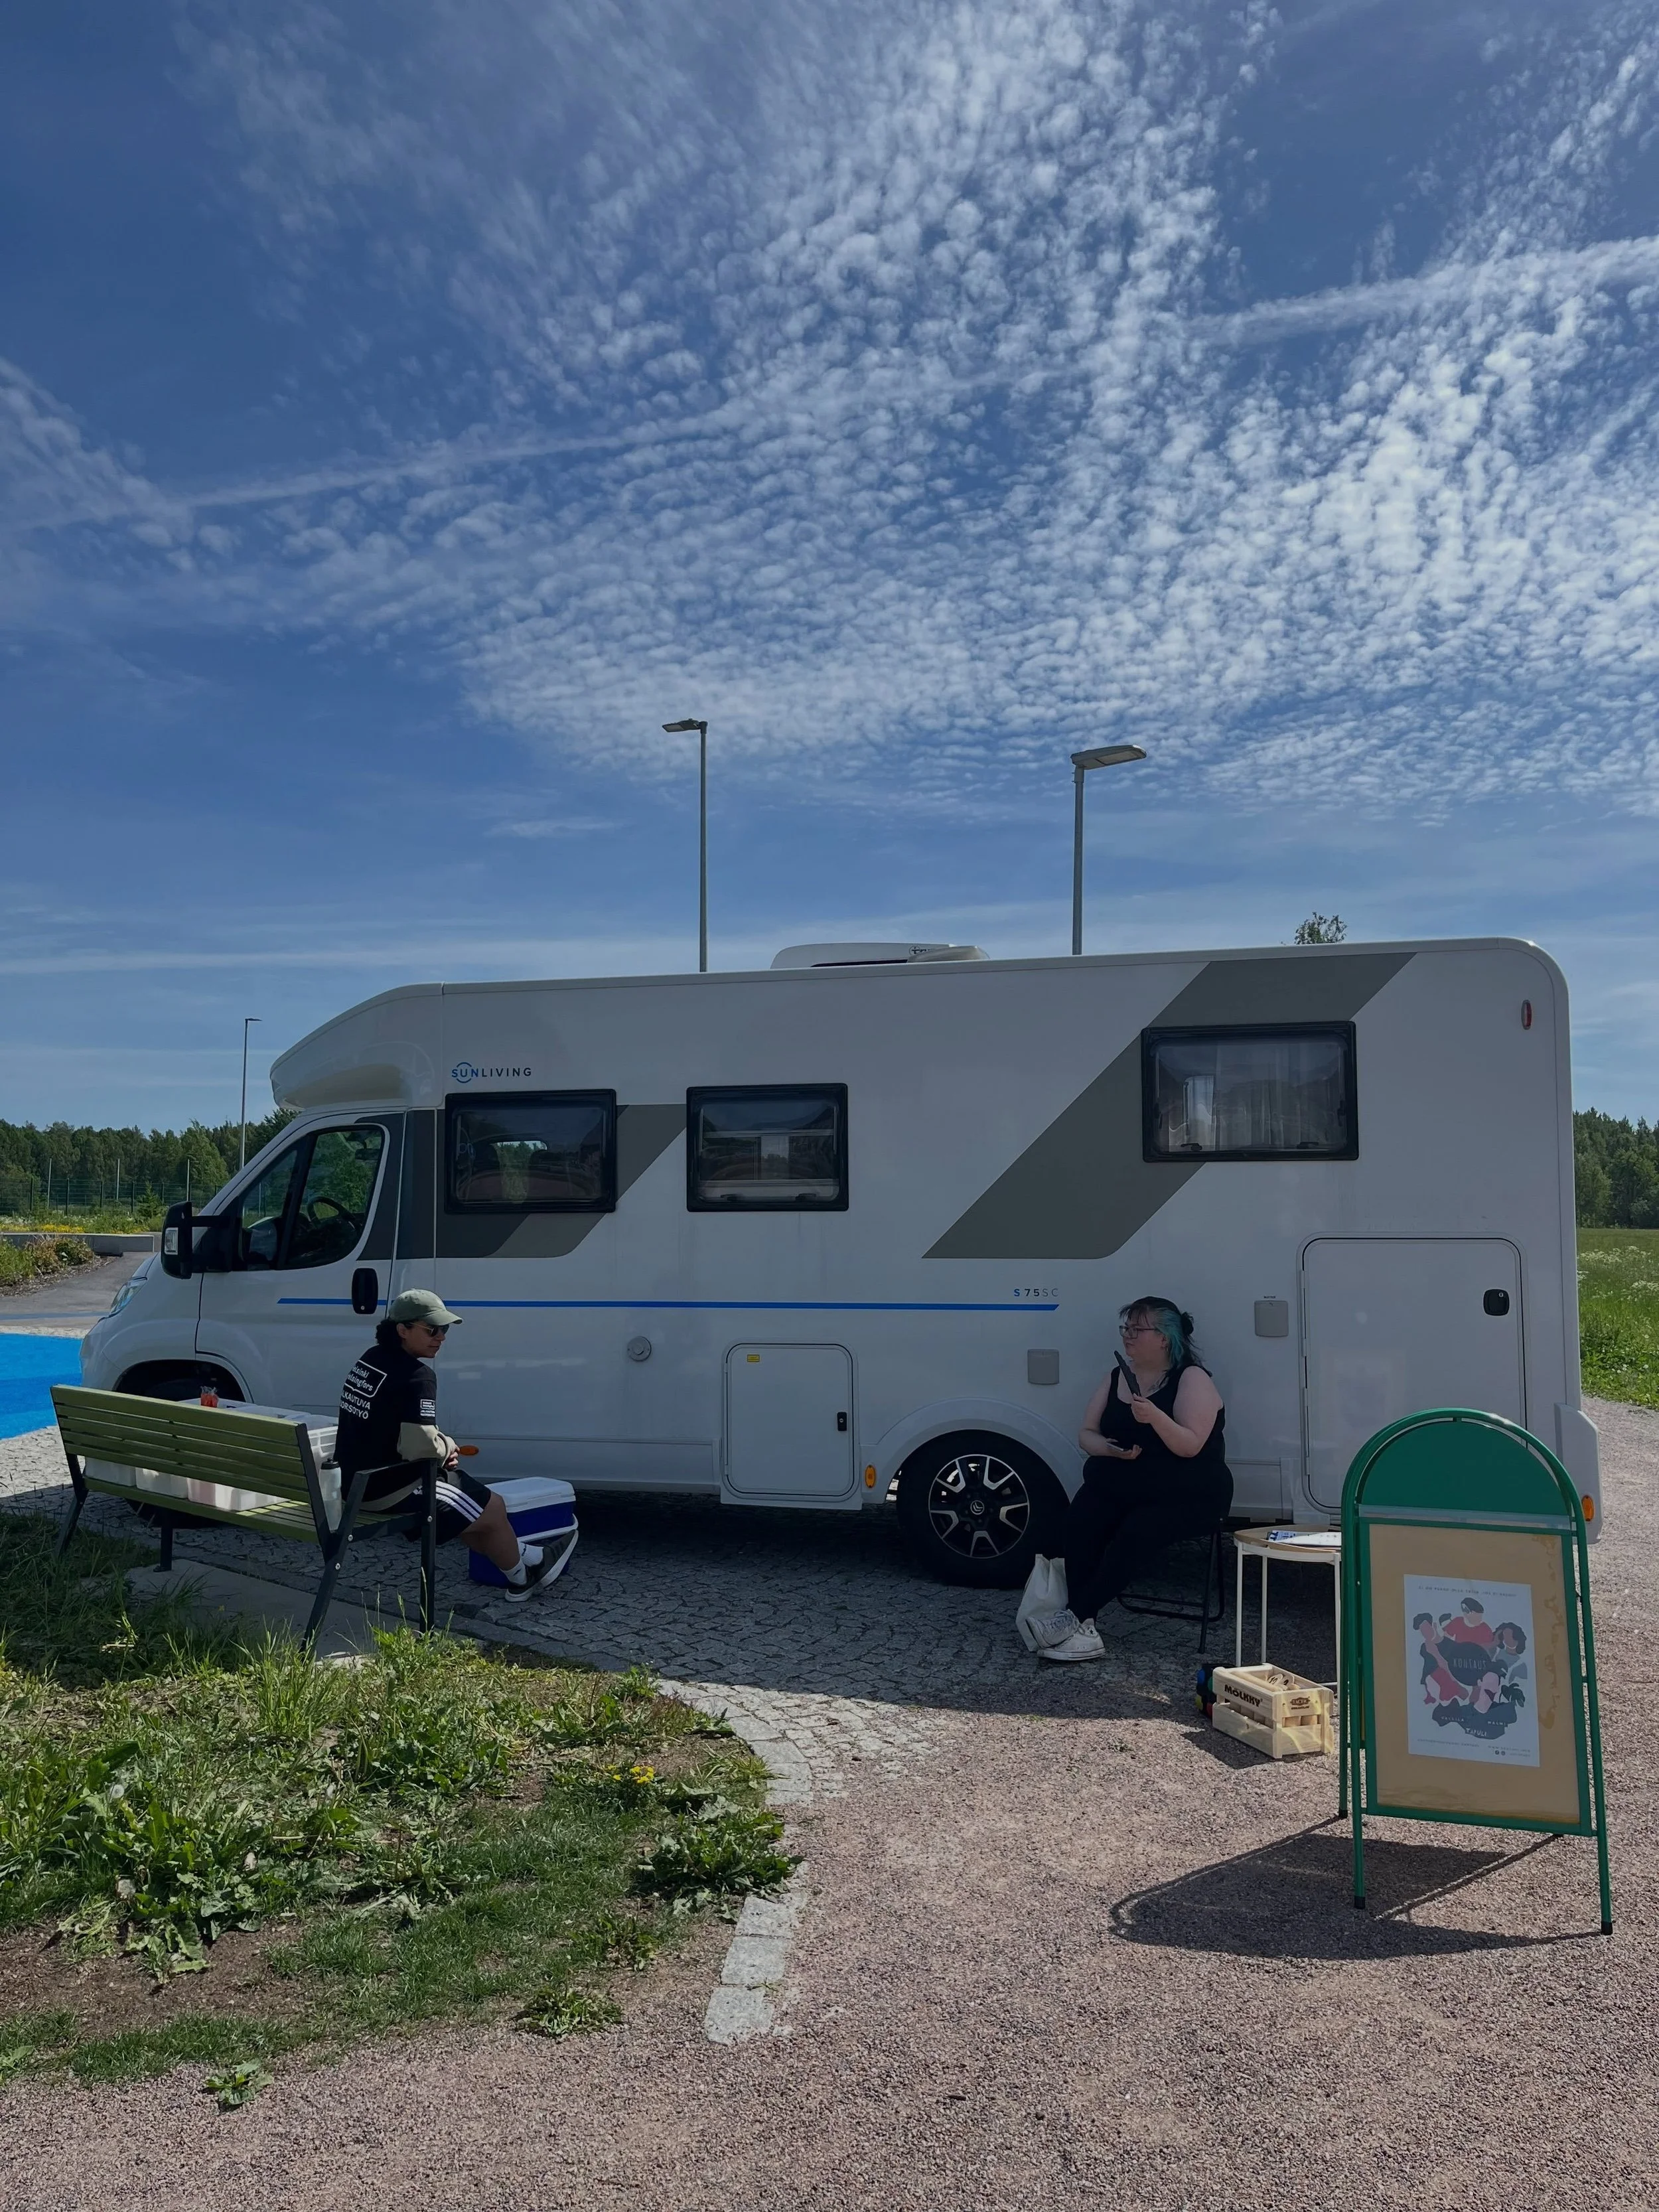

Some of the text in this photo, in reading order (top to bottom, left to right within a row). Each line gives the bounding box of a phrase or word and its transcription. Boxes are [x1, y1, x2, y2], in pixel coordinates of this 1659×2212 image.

[451, 1067, 532, 1078] SUNLIVING
[352, 1365, 370, 1379] elsinki
[347, 1373, 374, 1392] elsingfors
